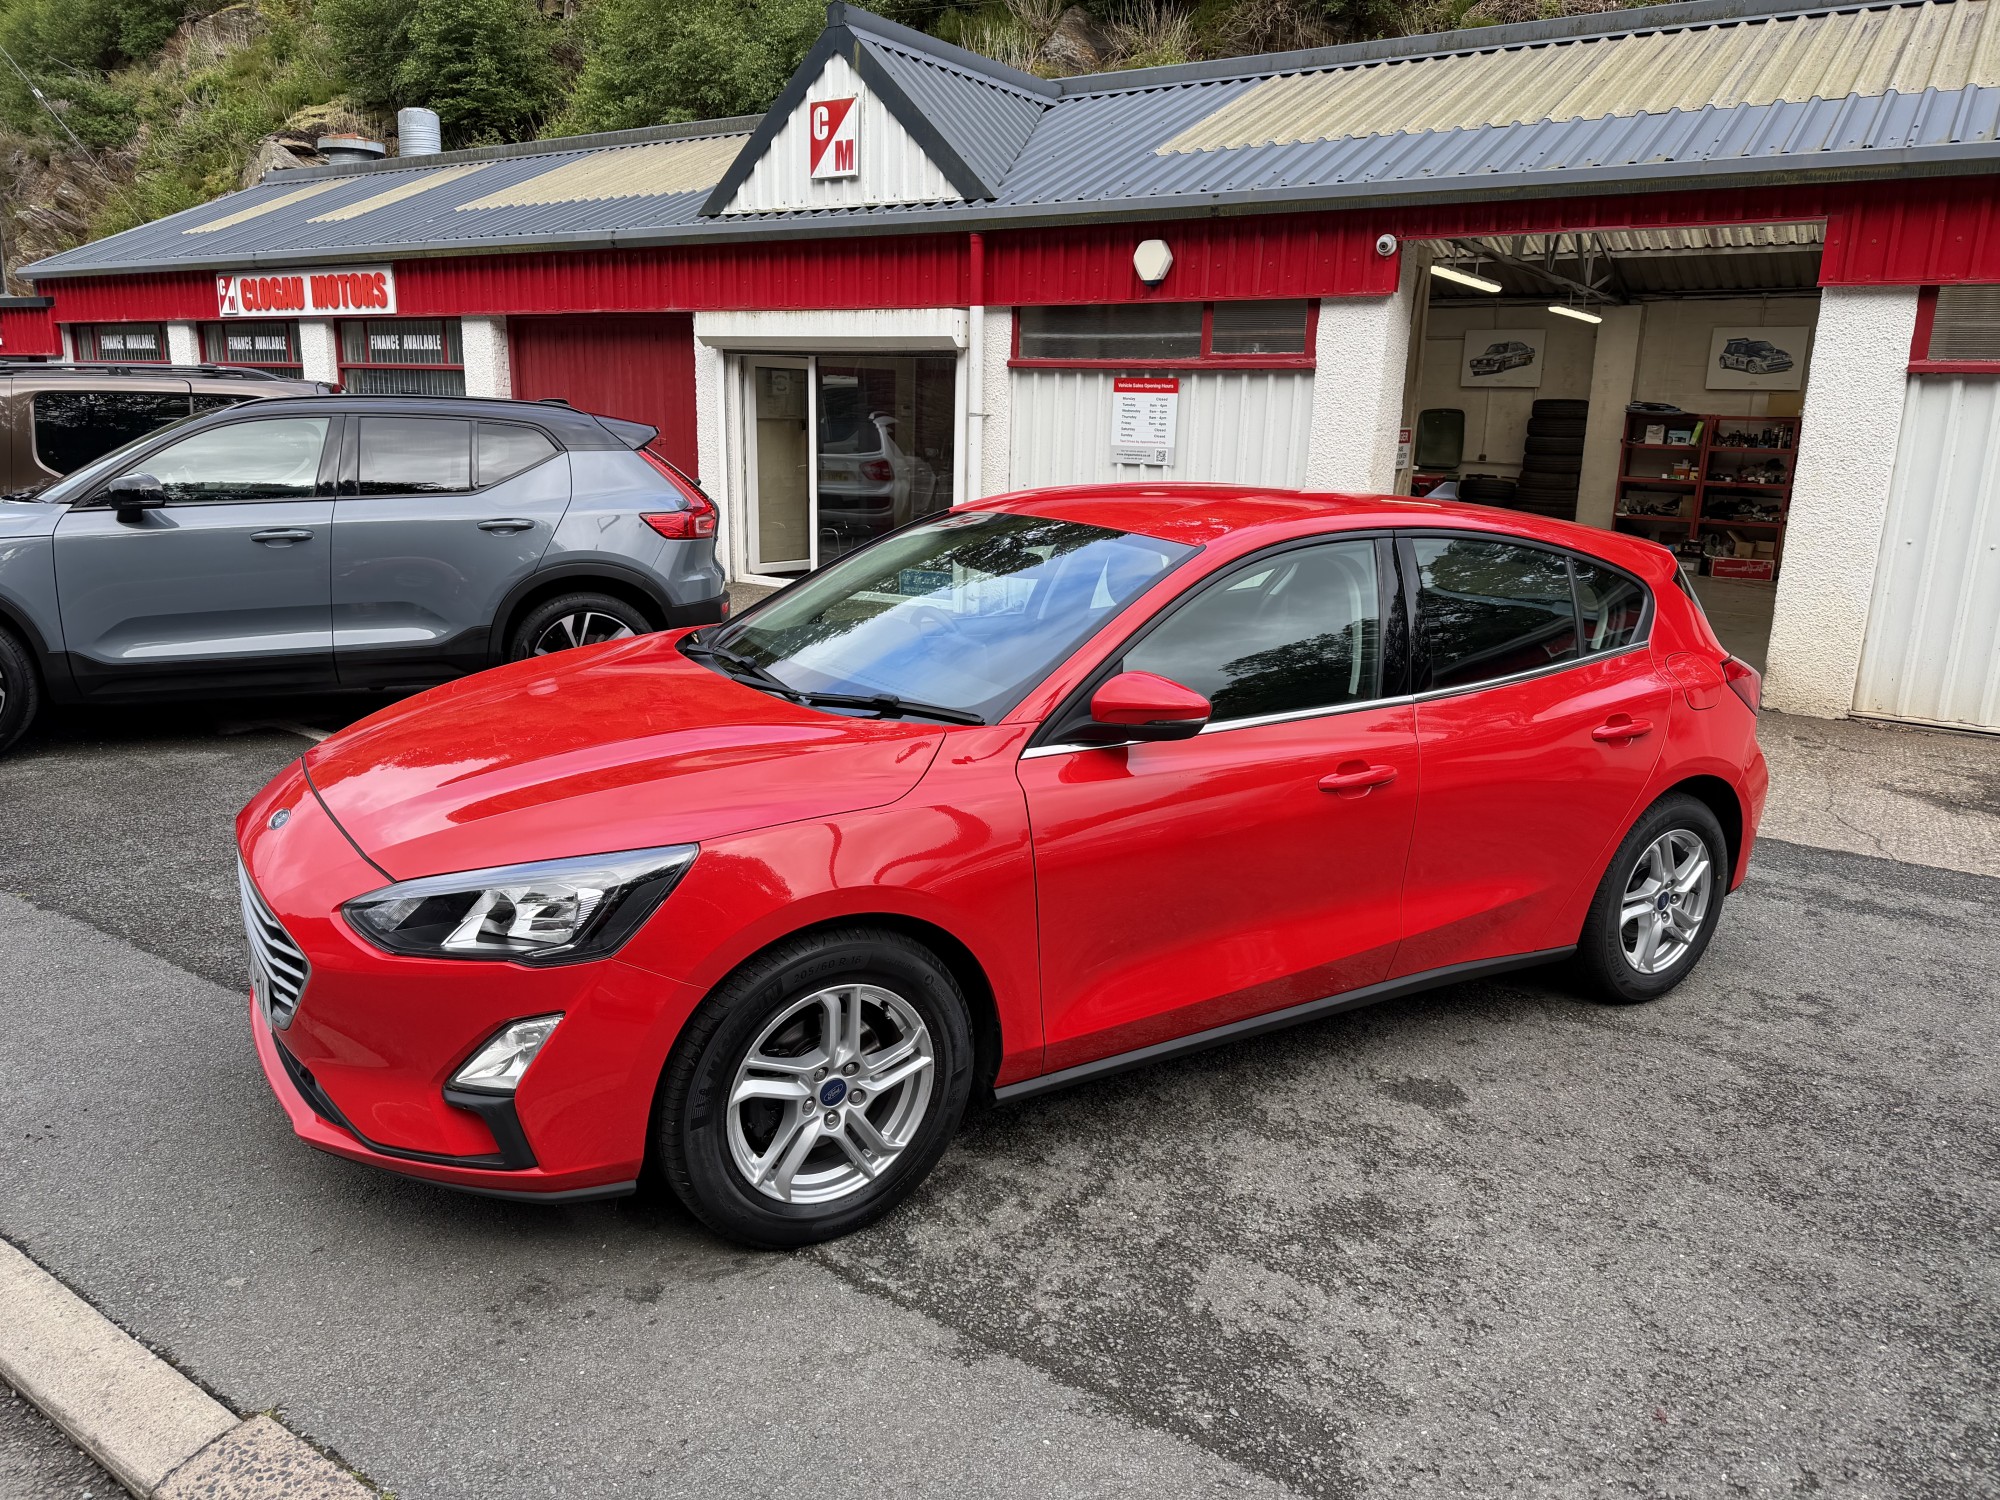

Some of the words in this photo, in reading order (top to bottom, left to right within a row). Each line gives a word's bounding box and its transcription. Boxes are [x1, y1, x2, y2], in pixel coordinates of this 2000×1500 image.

[240, 276, 305, 312] CLOGAU
[310, 272, 388, 310] MOTORS
[101, 335, 124, 350] FINANCE
[126, 334, 156, 350] AVAILABLE
[228, 336, 252, 350] FINANCE
[255, 336, 286, 350] AVAILABLE
[370, 335, 400, 350] FINANCE
[403, 335, 441, 350] AVAILABLE
[793, 959, 835, 984] 205/60
